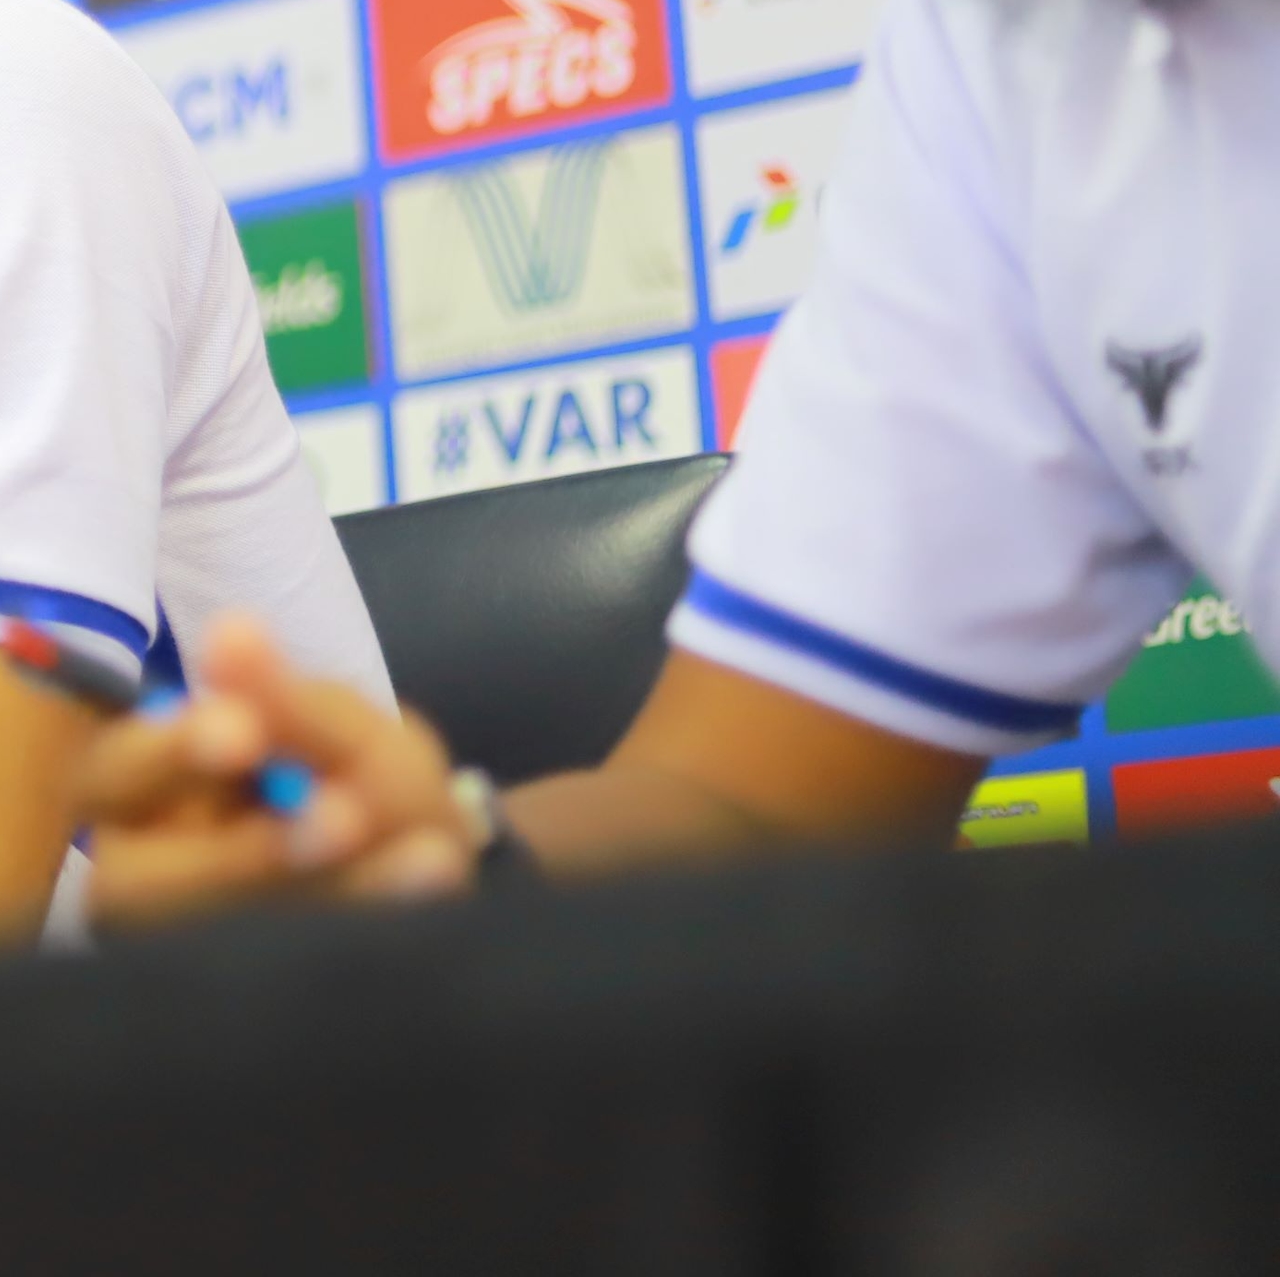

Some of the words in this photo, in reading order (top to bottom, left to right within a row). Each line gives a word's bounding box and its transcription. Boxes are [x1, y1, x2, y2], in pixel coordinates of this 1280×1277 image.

[175, 60, 292, 147] CM
[428, 24, 635, 133] SPECS
[432, 378, 660, 474] #VAR
